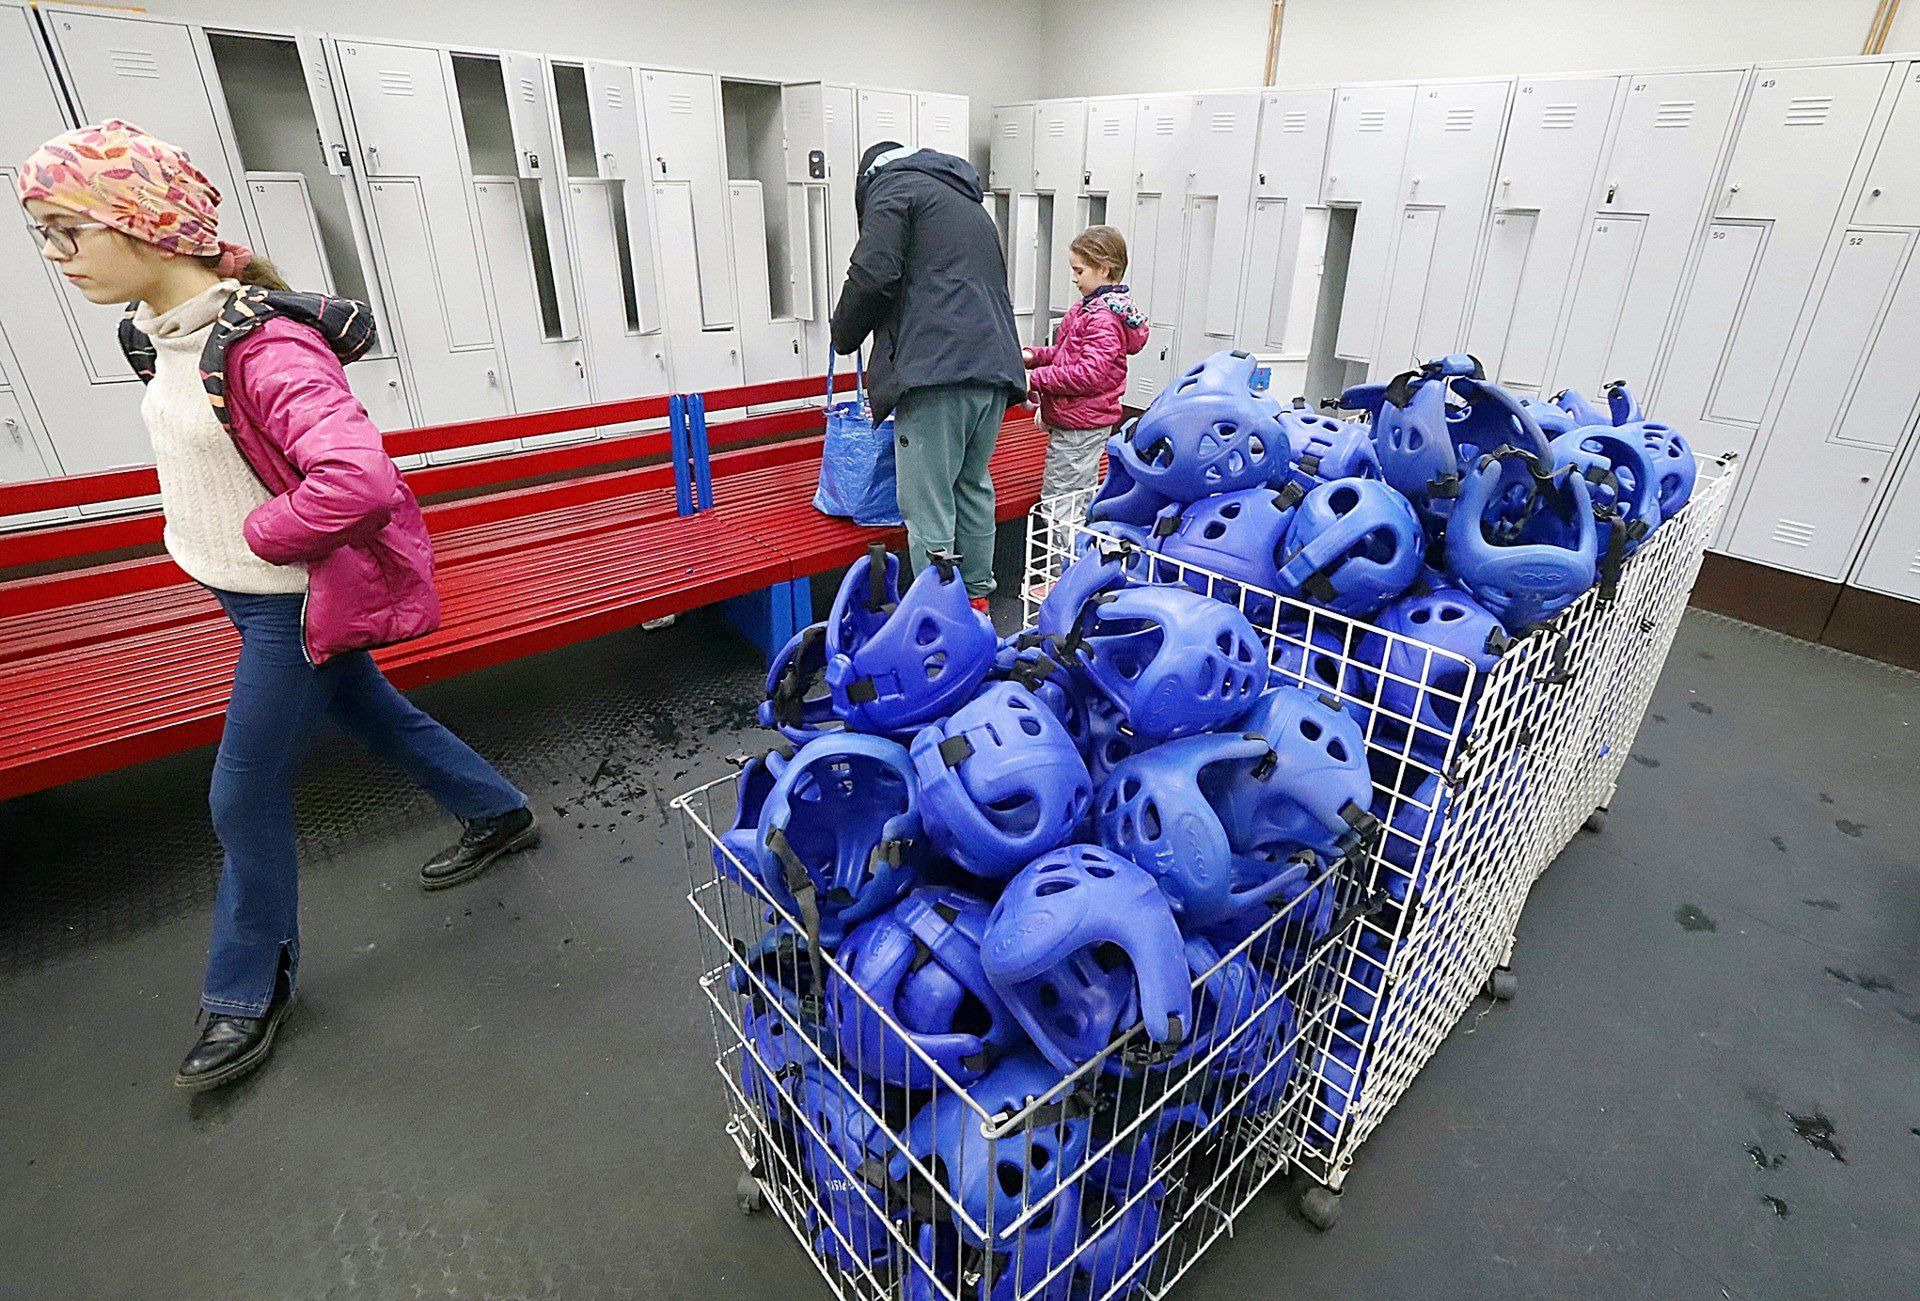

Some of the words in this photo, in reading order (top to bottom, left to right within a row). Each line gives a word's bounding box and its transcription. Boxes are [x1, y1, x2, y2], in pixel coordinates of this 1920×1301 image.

[1761, 79, 1775, 88] 49
[1713, 231, 1725, 239] 50
[1850, 237, 1863, 246] 52
